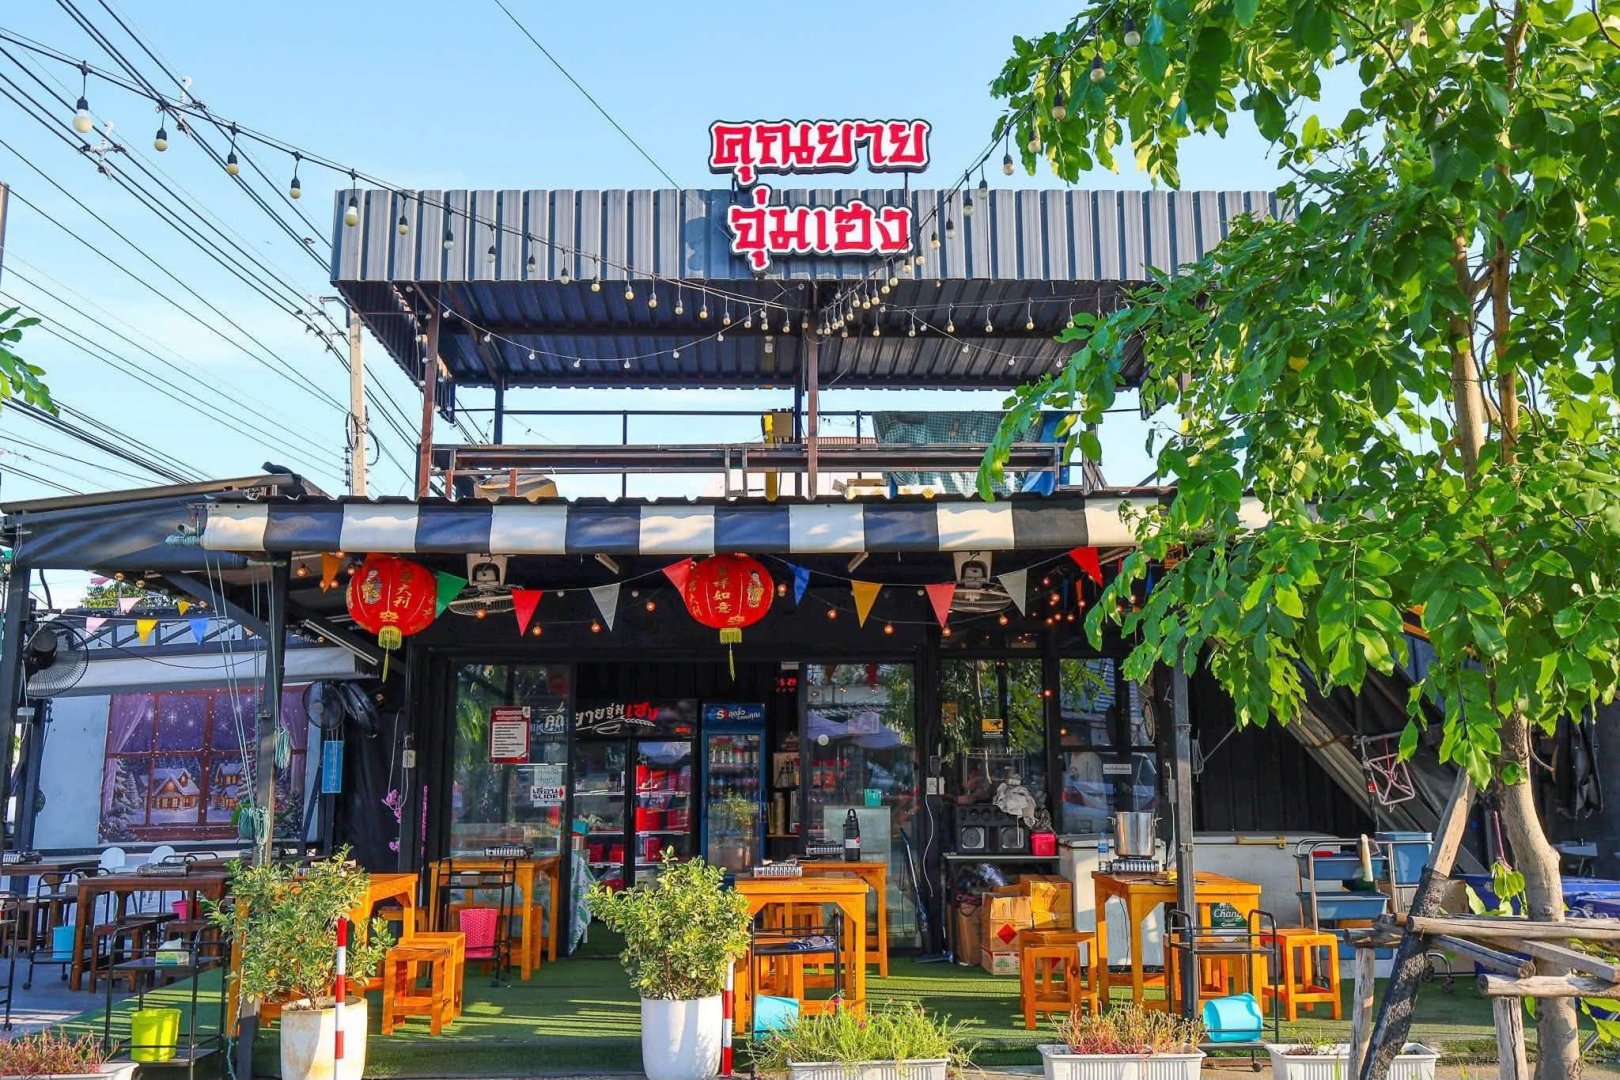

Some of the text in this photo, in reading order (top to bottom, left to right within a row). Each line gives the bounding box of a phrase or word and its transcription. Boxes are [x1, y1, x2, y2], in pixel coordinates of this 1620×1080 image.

[711, 121, 929, 185] คุณยาย
[729, 186, 911, 268] จุ่มเฮง
[1213, 908, 1242, 918] Chang
